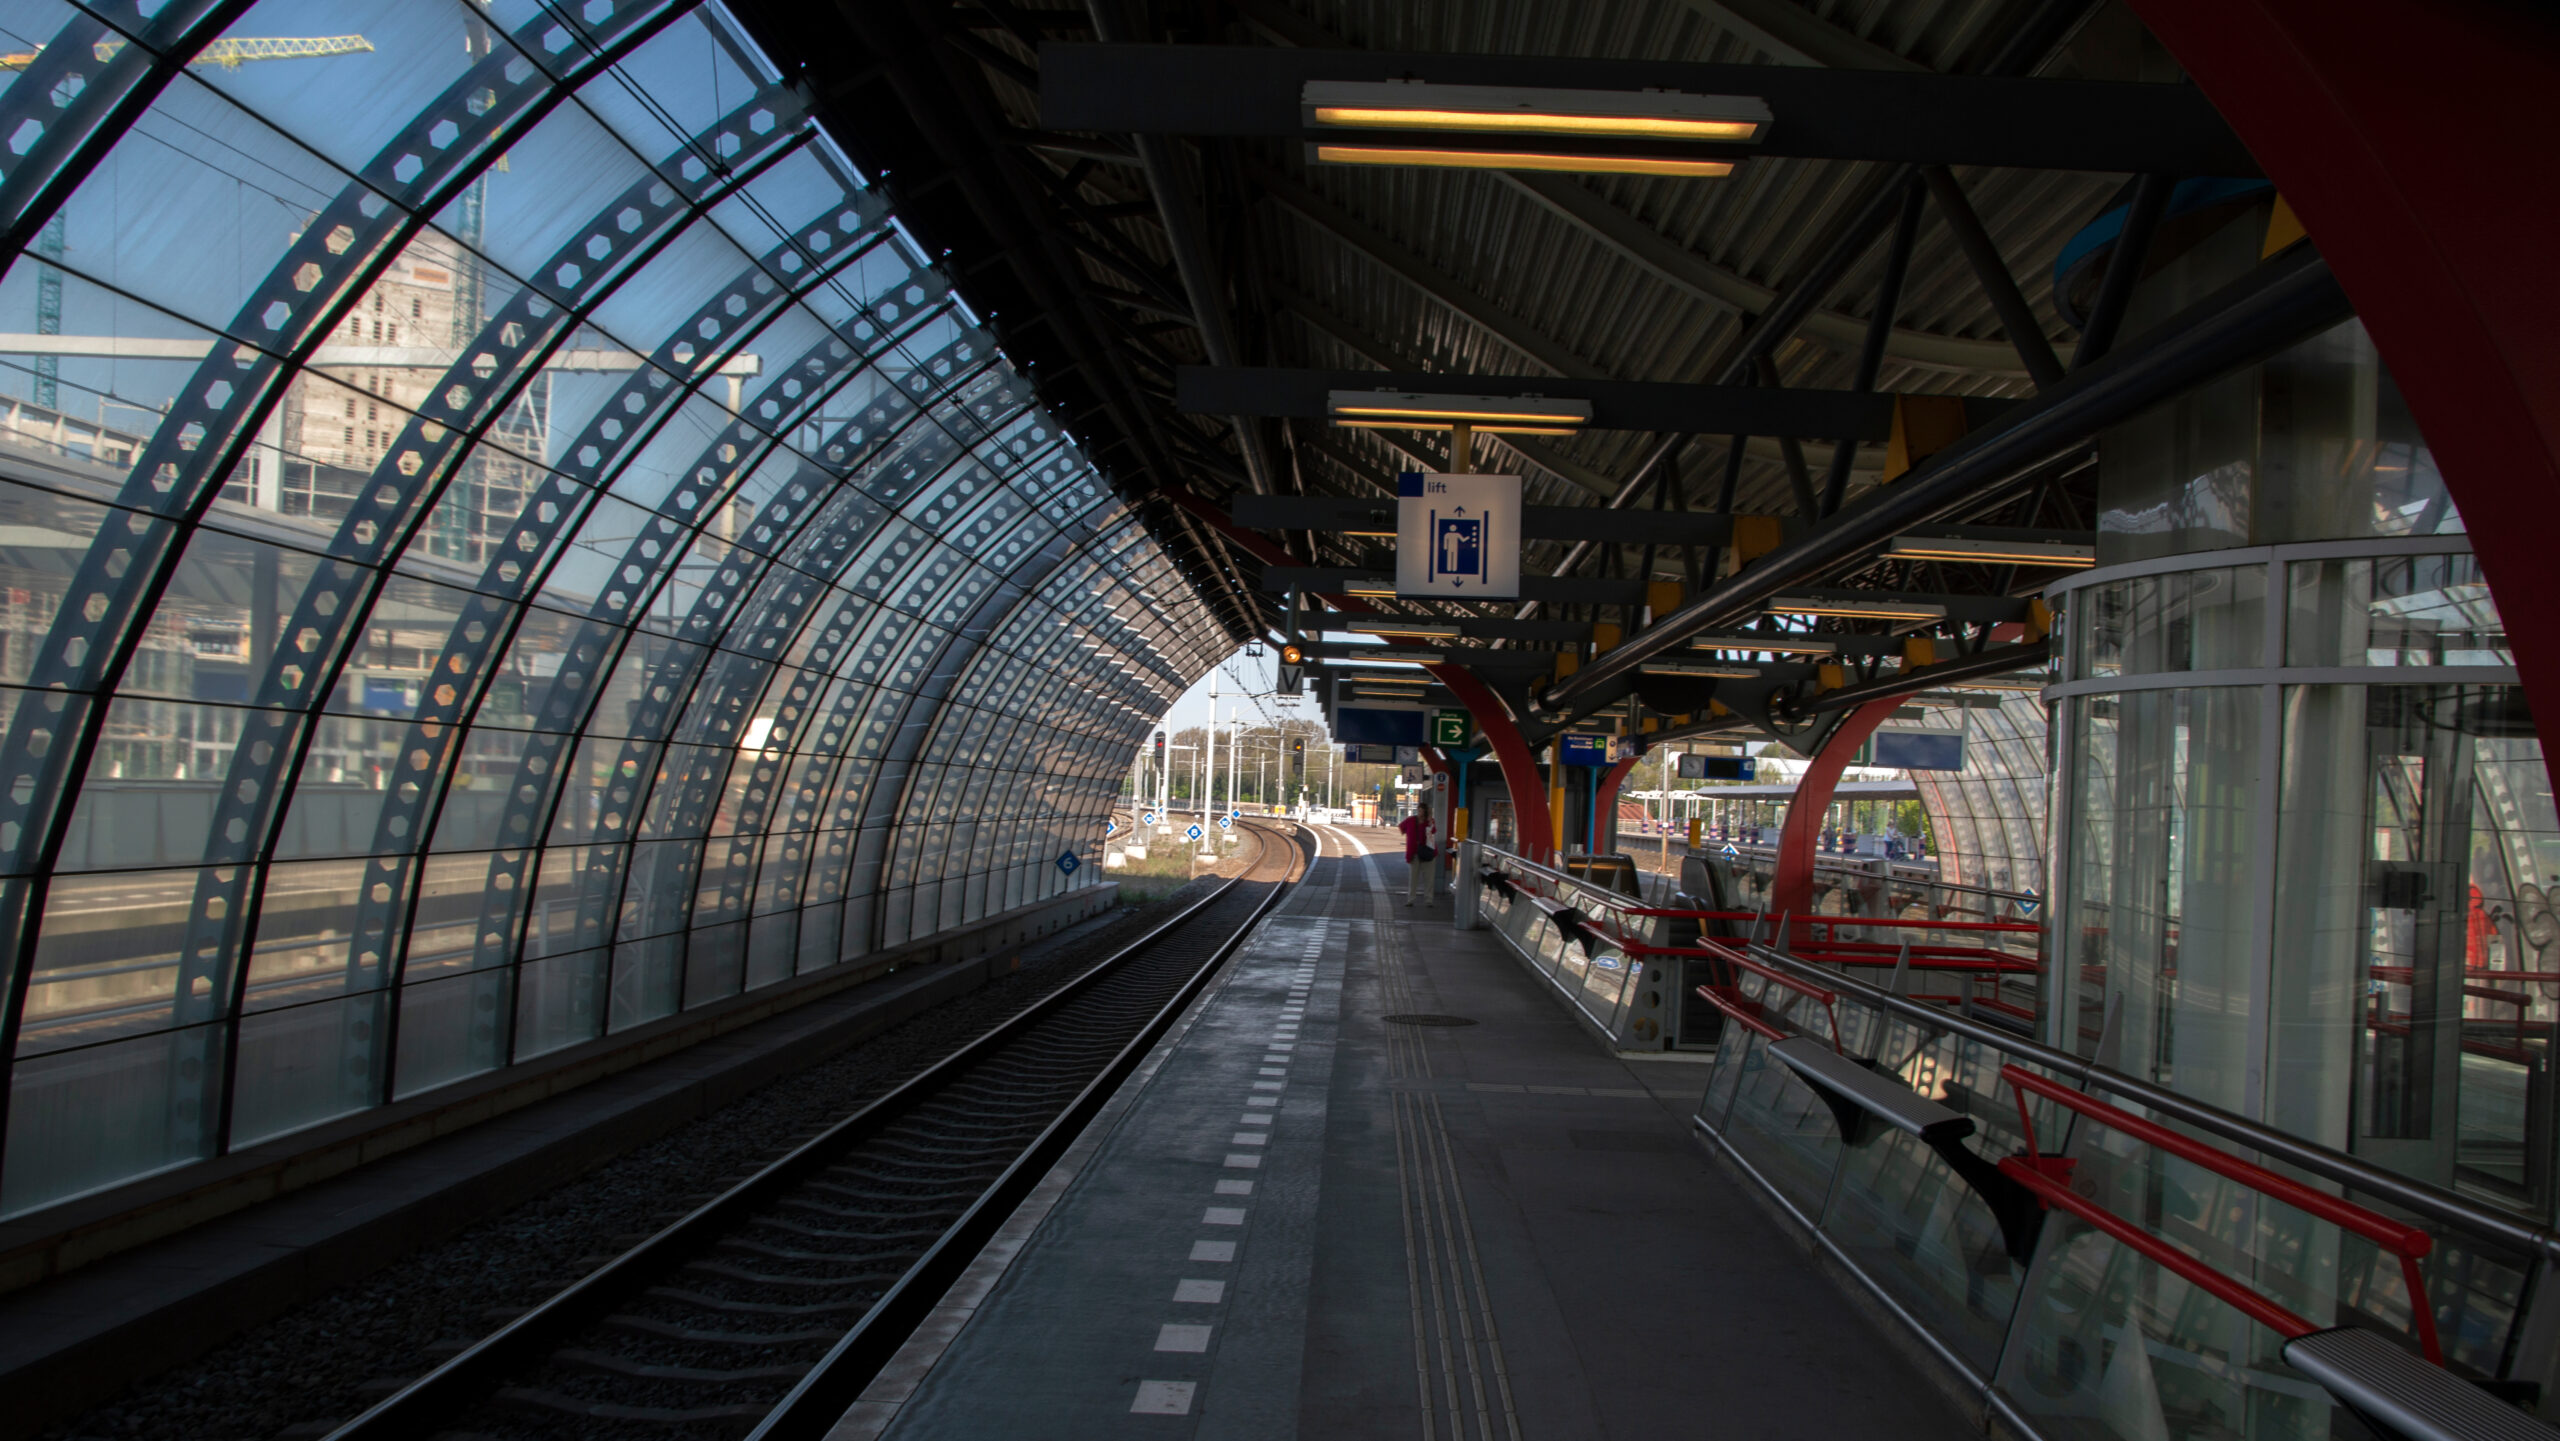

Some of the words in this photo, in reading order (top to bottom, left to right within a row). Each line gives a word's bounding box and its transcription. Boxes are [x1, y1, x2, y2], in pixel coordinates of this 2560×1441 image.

[1427, 482, 1447, 493] lift
[1281, 667, 1301, 692] V
[1063, 857, 1073, 869] 6
